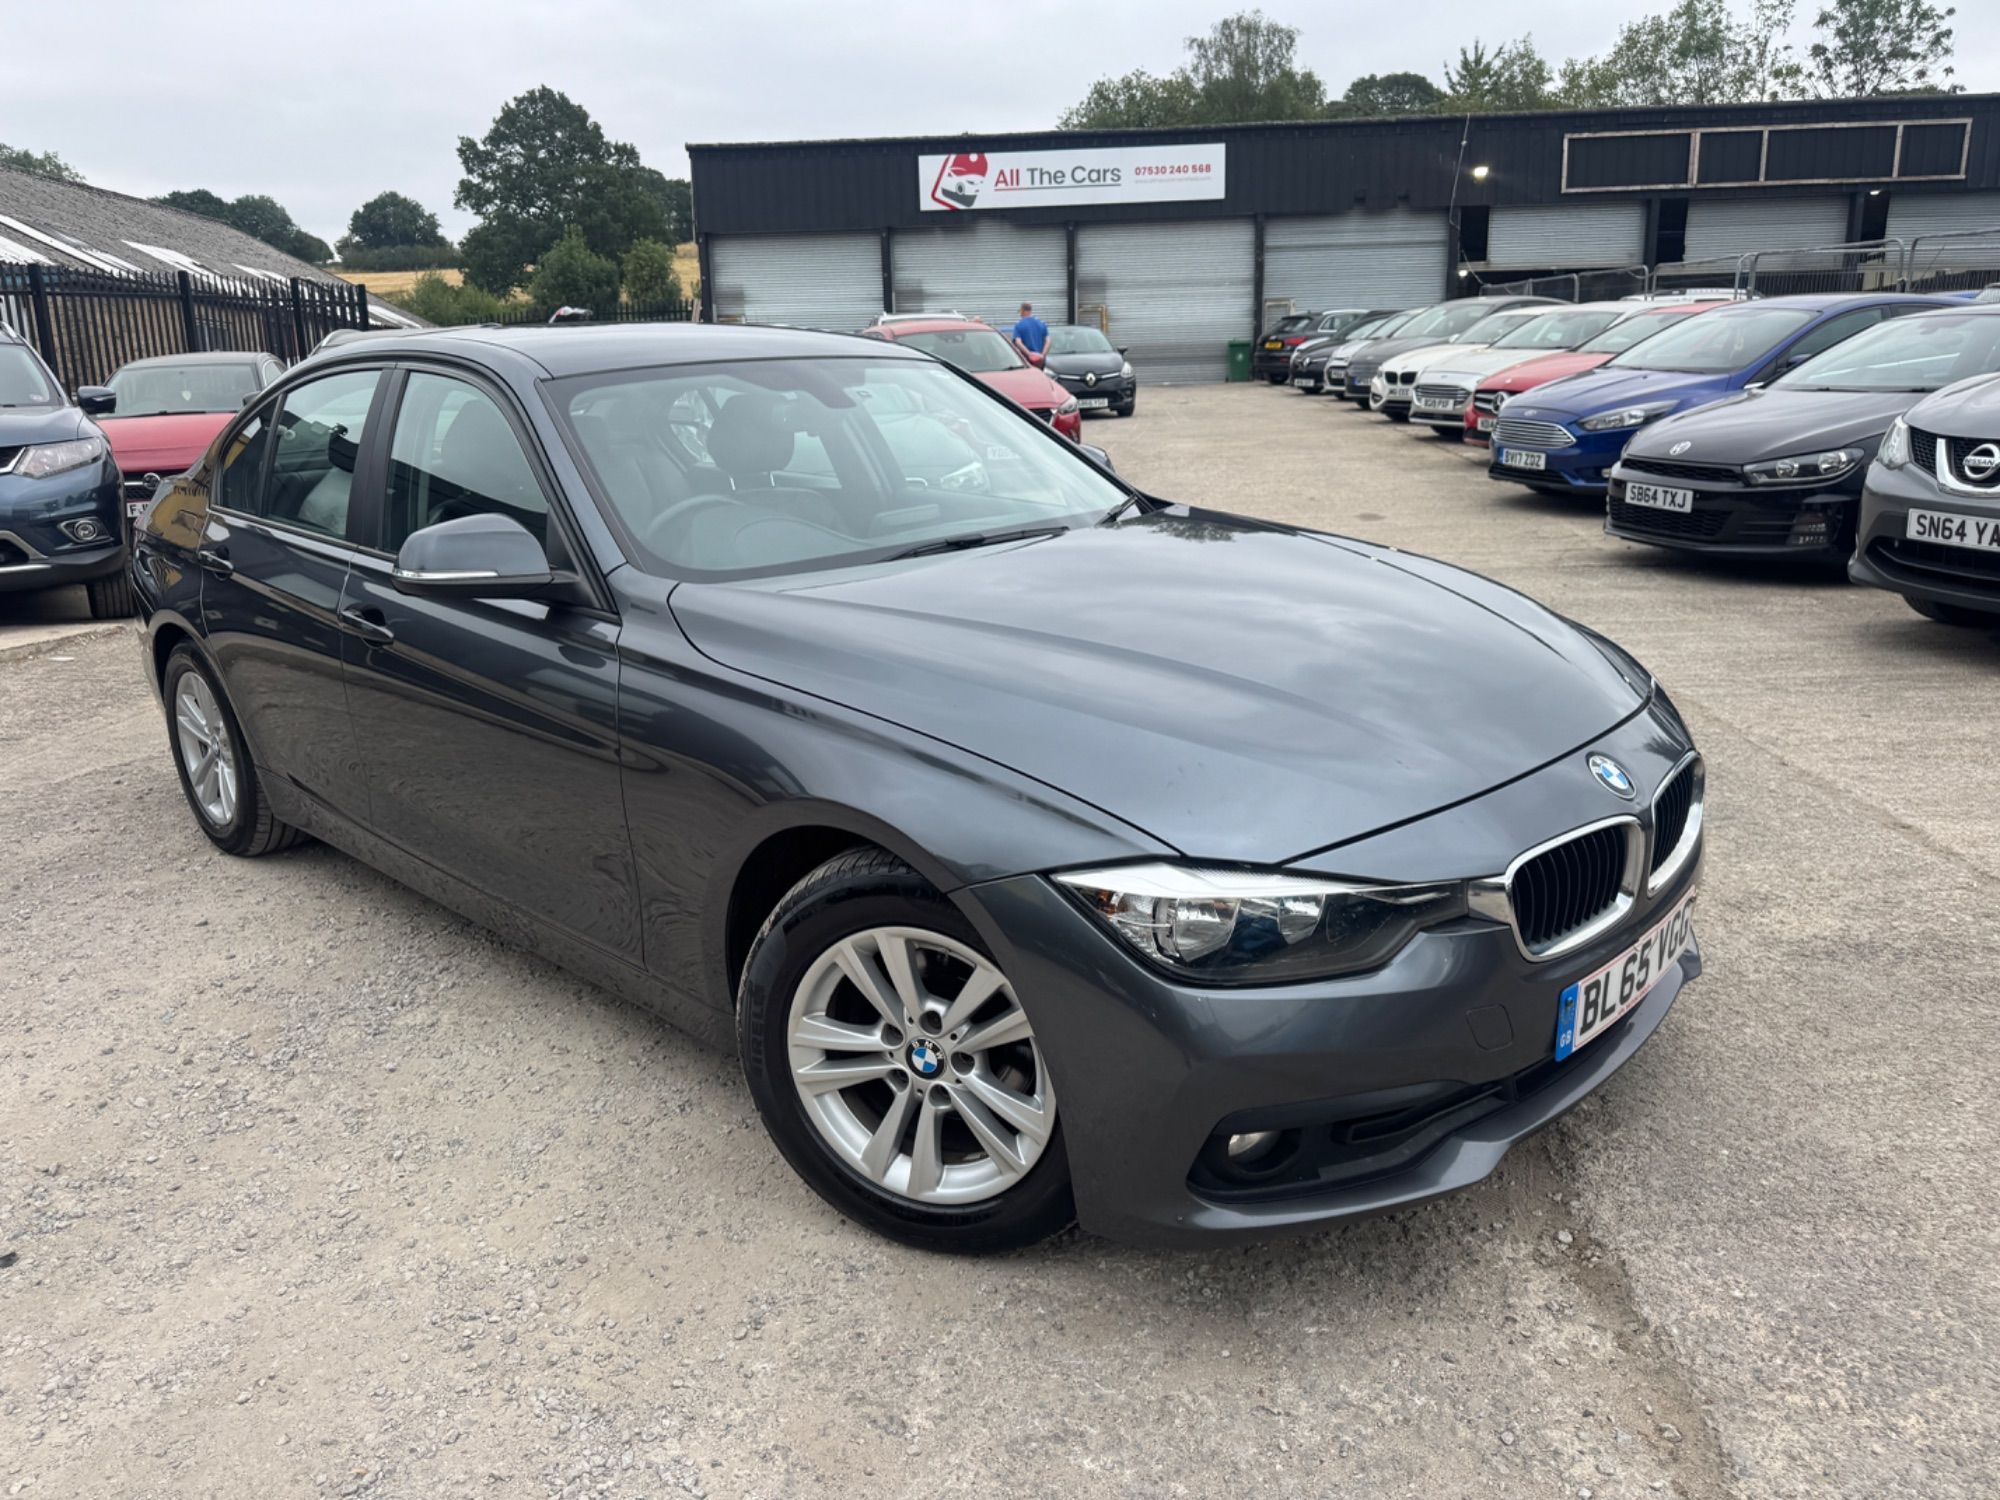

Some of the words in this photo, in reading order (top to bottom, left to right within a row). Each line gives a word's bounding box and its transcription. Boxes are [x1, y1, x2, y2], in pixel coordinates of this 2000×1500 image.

[994, 168, 1020, 187] All
[1026, 167, 1066, 186] The
[1070, 165, 1121, 184] Cars
[1135, 165, 1167, 176] 07530
[1169, 164, 1189, 175] 240
[1191, 163, 1211, 174] 568
[1629, 485, 1659, 505] SB64
[1661, 489, 1687, 509] TXJ
[1916, 513, 1967, 543] SN64
[1579, 936, 1654, 1037] BL65
[1560, 1030, 1572, 1048] GB
